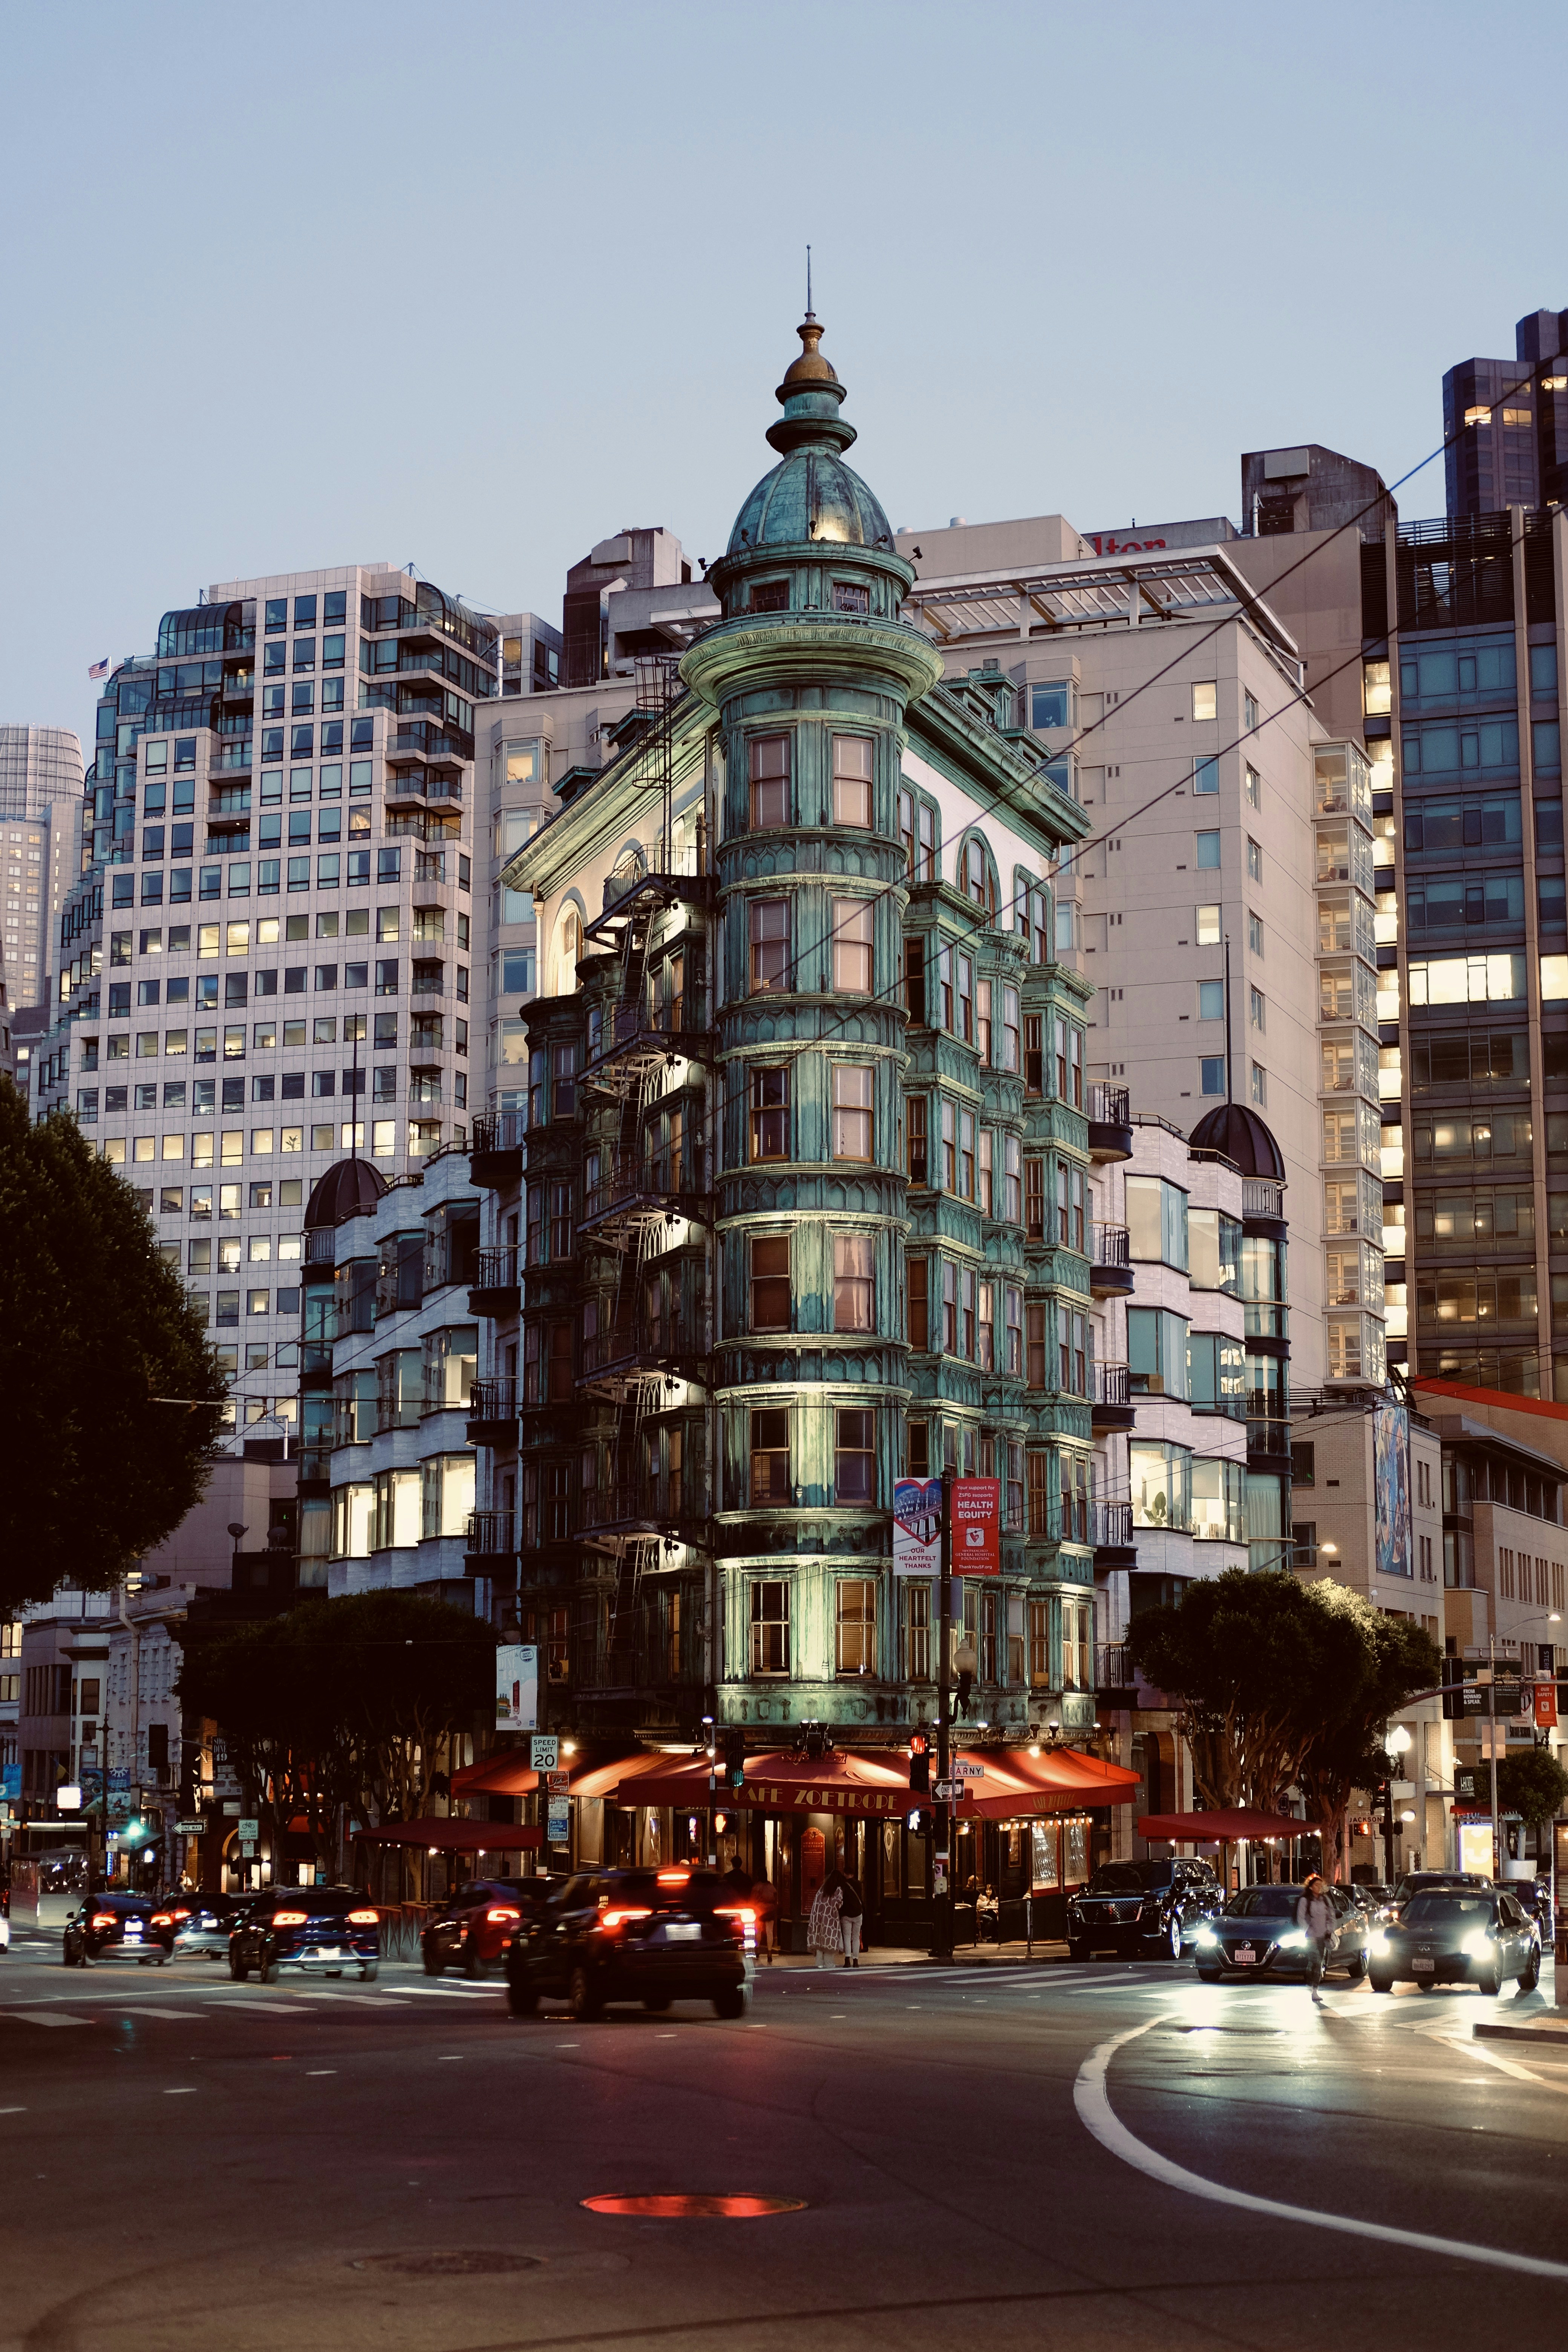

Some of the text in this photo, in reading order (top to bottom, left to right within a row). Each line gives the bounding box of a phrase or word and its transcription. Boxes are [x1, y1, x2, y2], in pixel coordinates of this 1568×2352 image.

[214, 1745, 227, 1753] DINE
[534, 1754, 555, 1767] 20
[733, 1787, 897, 1810] CAFE ZOETROPE
